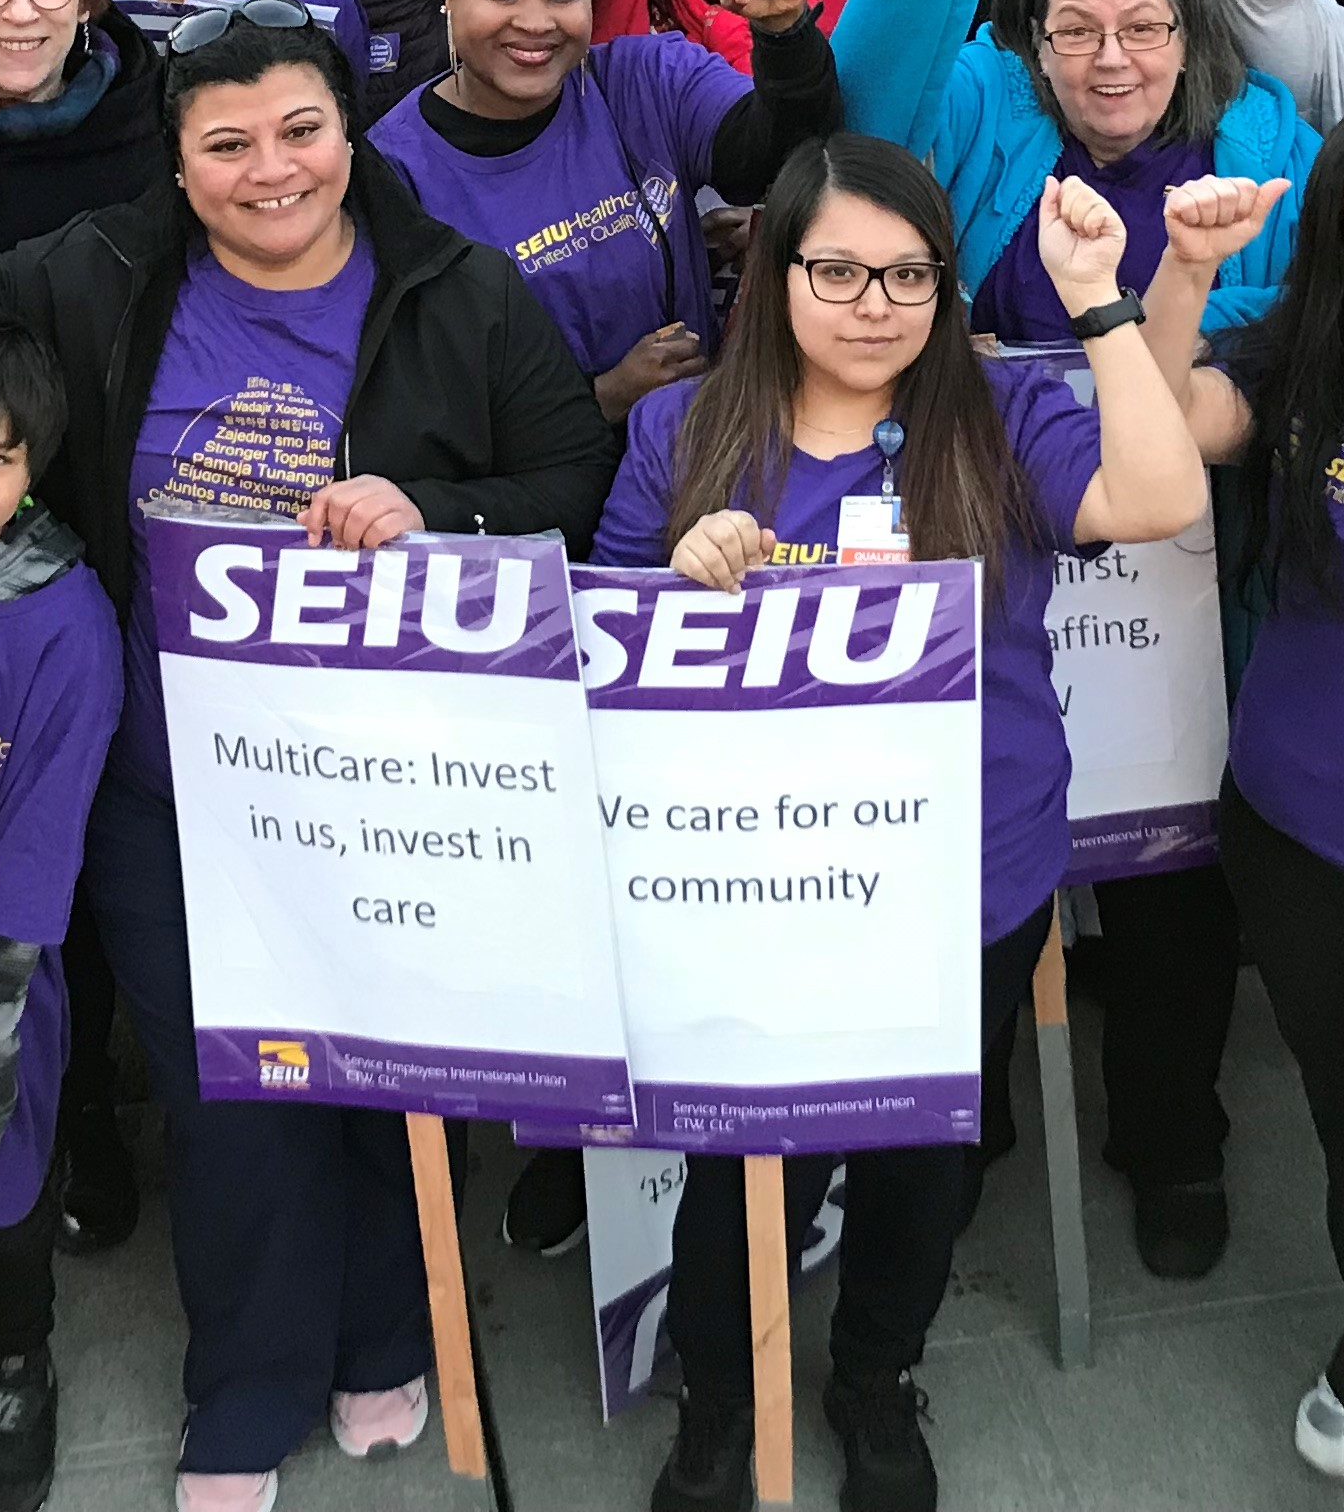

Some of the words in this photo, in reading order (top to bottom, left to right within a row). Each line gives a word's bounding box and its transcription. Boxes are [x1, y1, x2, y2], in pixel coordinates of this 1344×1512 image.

[522, 244, 572, 275] United
[571, 236, 589, 253] fo
[590, 212, 639, 242] Quality
[203, 440, 269, 462] Stronger
[272, 448, 337, 469] Together
[214, 425, 272, 446] Zajedno
[274, 434, 304, 448] smo
[192, 452, 253, 476] Pamoja
[164, 476, 215, 501] Juntos
[219, 491, 272, 511] somos
[188, 543, 533, 654] SEIU
[579, 582, 940, 692] SEIU
[1047, 614, 1160, 651] affing,
[213, 733, 417, 786] MultiCare:
[432, 750, 558, 795] Invest
[665, 794, 760, 833] care
[775, 791, 836, 831] for
[853, 792, 930, 830] our
[248, 805, 283, 842] in
[294, 822, 348, 858] us,
[360, 818, 483, 862] invest
[496, 828, 532, 864] in
[1072, 828, 1142, 850] International
[1144, 824, 1181, 838] Union
[628, 865, 881, 908] community
[351, 892, 437, 930] care
[260, 1065, 310, 1082] SEIU
[344, 1053, 384, 1071] Service
[386, 1058, 448, 1081] Employees
[450, 1065, 526, 1087] International
[528, 1071, 567, 1088] Union
[376, 1074, 400, 1088] CLC
[672, 1099, 718, 1116] Service
[720, 1101, 789, 1120] Employees
[792, 1097, 873, 1115] International
[875, 1094, 916, 1110] Union
[709, 1118, 735, 1131] CLC
[640, 1161, 685, 1205] rst,
